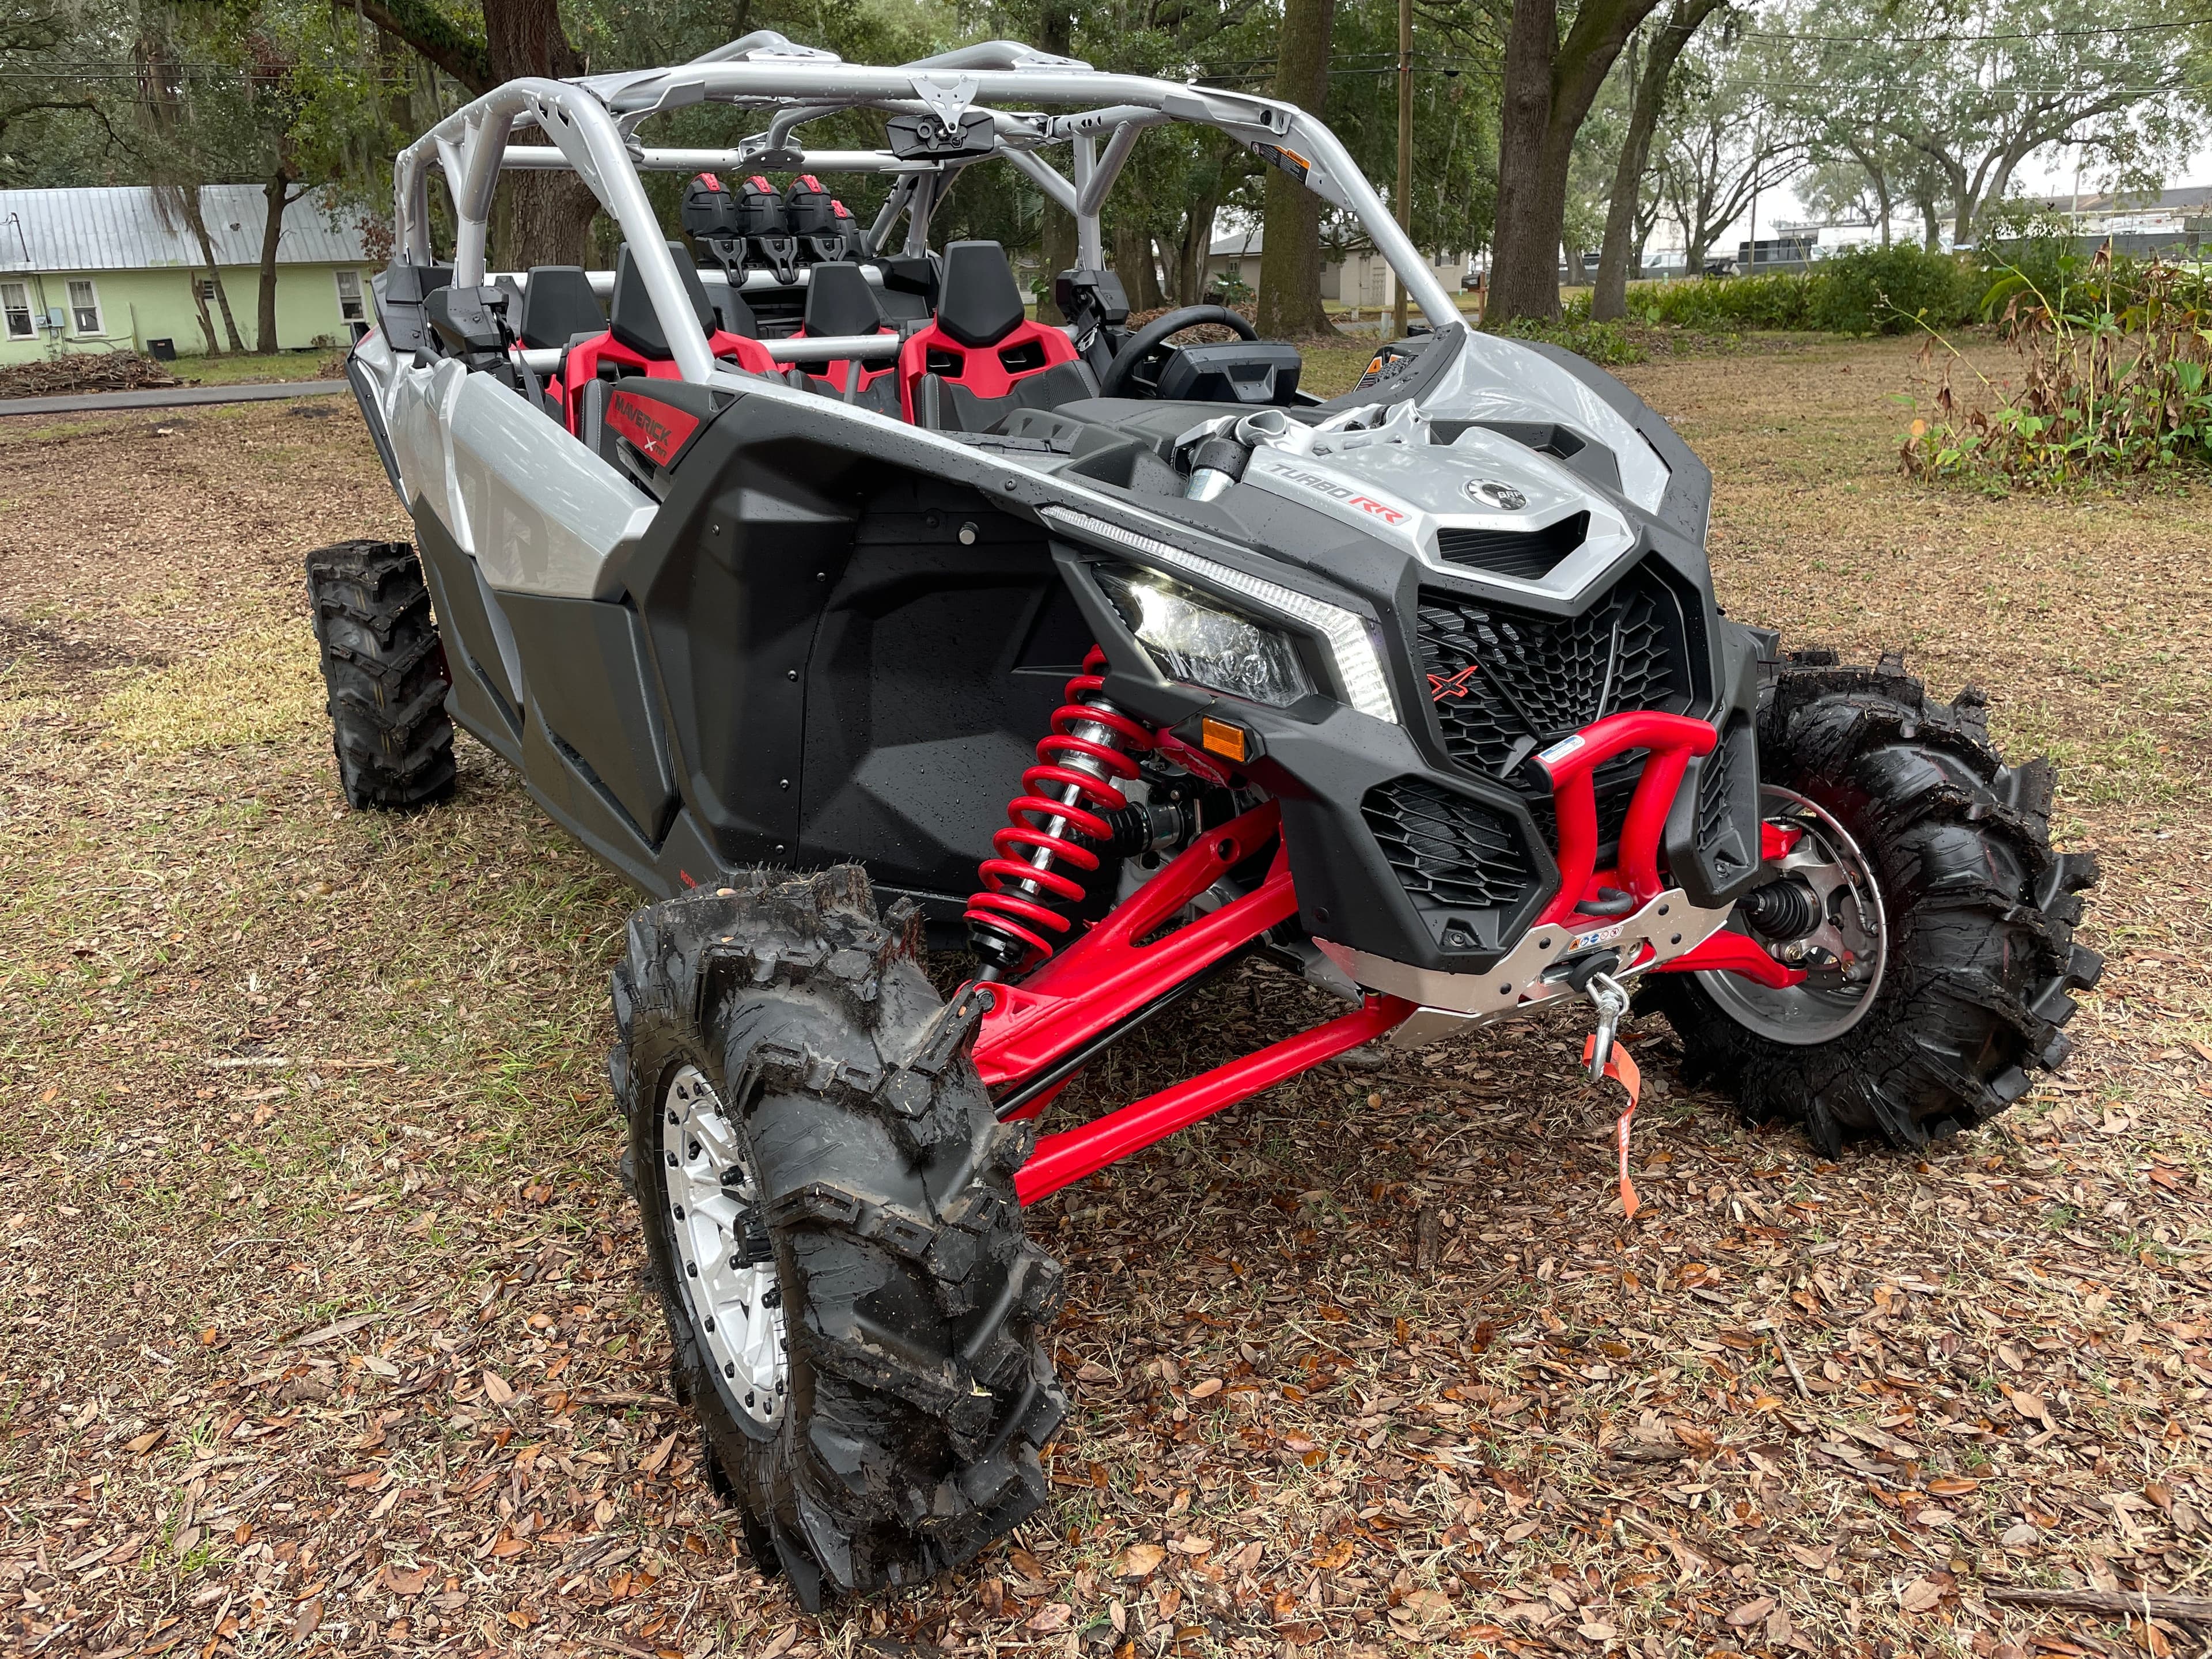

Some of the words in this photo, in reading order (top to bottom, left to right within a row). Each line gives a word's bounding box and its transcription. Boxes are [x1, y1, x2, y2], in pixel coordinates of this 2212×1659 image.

[615, 394, 672, 446] MAVERICK
[1270, 463, 1354, 499] TURBO
[1348, 496, 1404, 524] RR
[1497, 490, 1522, 499] BRP
[680, 869, 698, 888] ROTA
